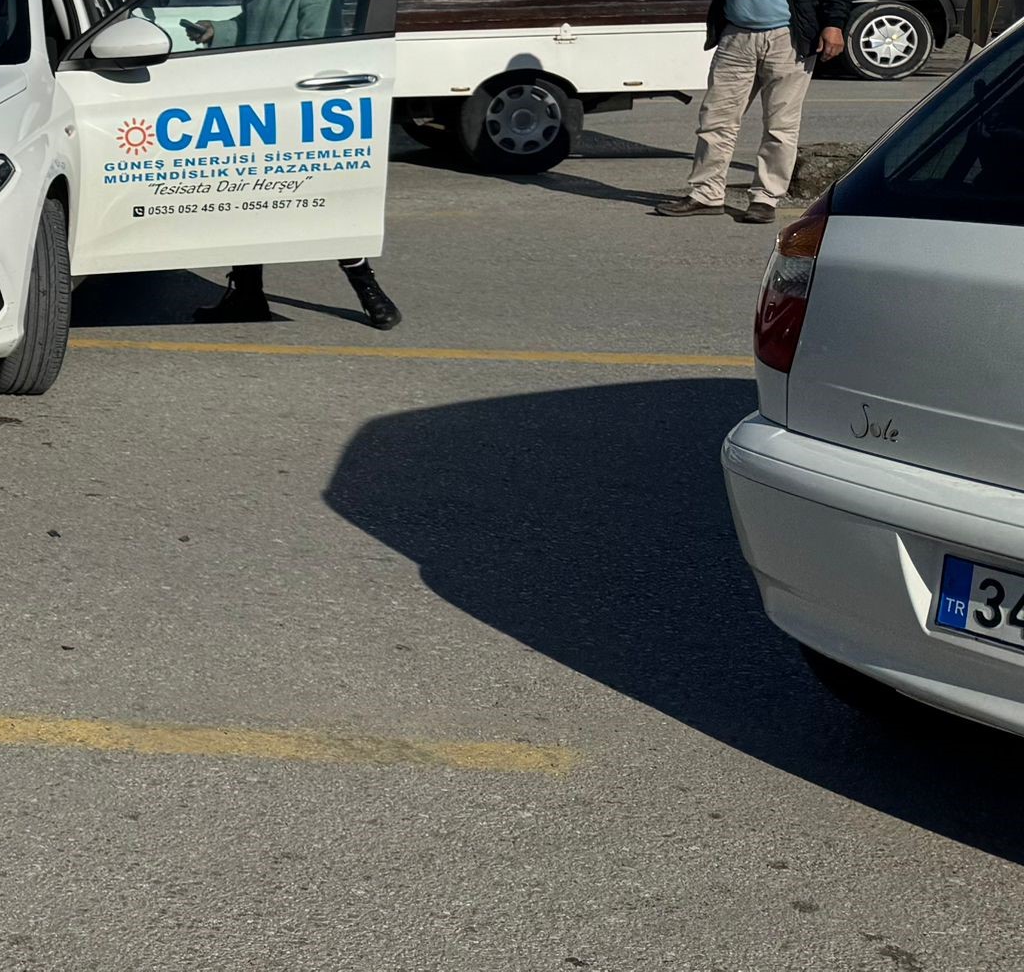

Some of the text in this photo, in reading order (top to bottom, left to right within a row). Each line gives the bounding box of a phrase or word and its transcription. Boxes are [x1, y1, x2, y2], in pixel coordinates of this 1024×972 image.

[156, 97, 373, 151] CAN ISI
[104, 145, 371, 171] GÜNEŞ ENERJİSİ SİSTEMLERİ
[104, 160, 371, 184] MÜHENDİSLIK VE PAZARLAMA
[216, 179, 250, 193] Dair
[148, 205, 174, 215] 0535
[178, 204, 198, 213] 052
[201, 203, 215, 212] 45
[218, 202, 231, 211] 63
[242, 201, 268, 210] 0554
[272, 199, 292, 209] 857
[296, 199, 309, 208] 78
[312, 198, 326, 207] 52
[946, 597, 965, 617] TR
